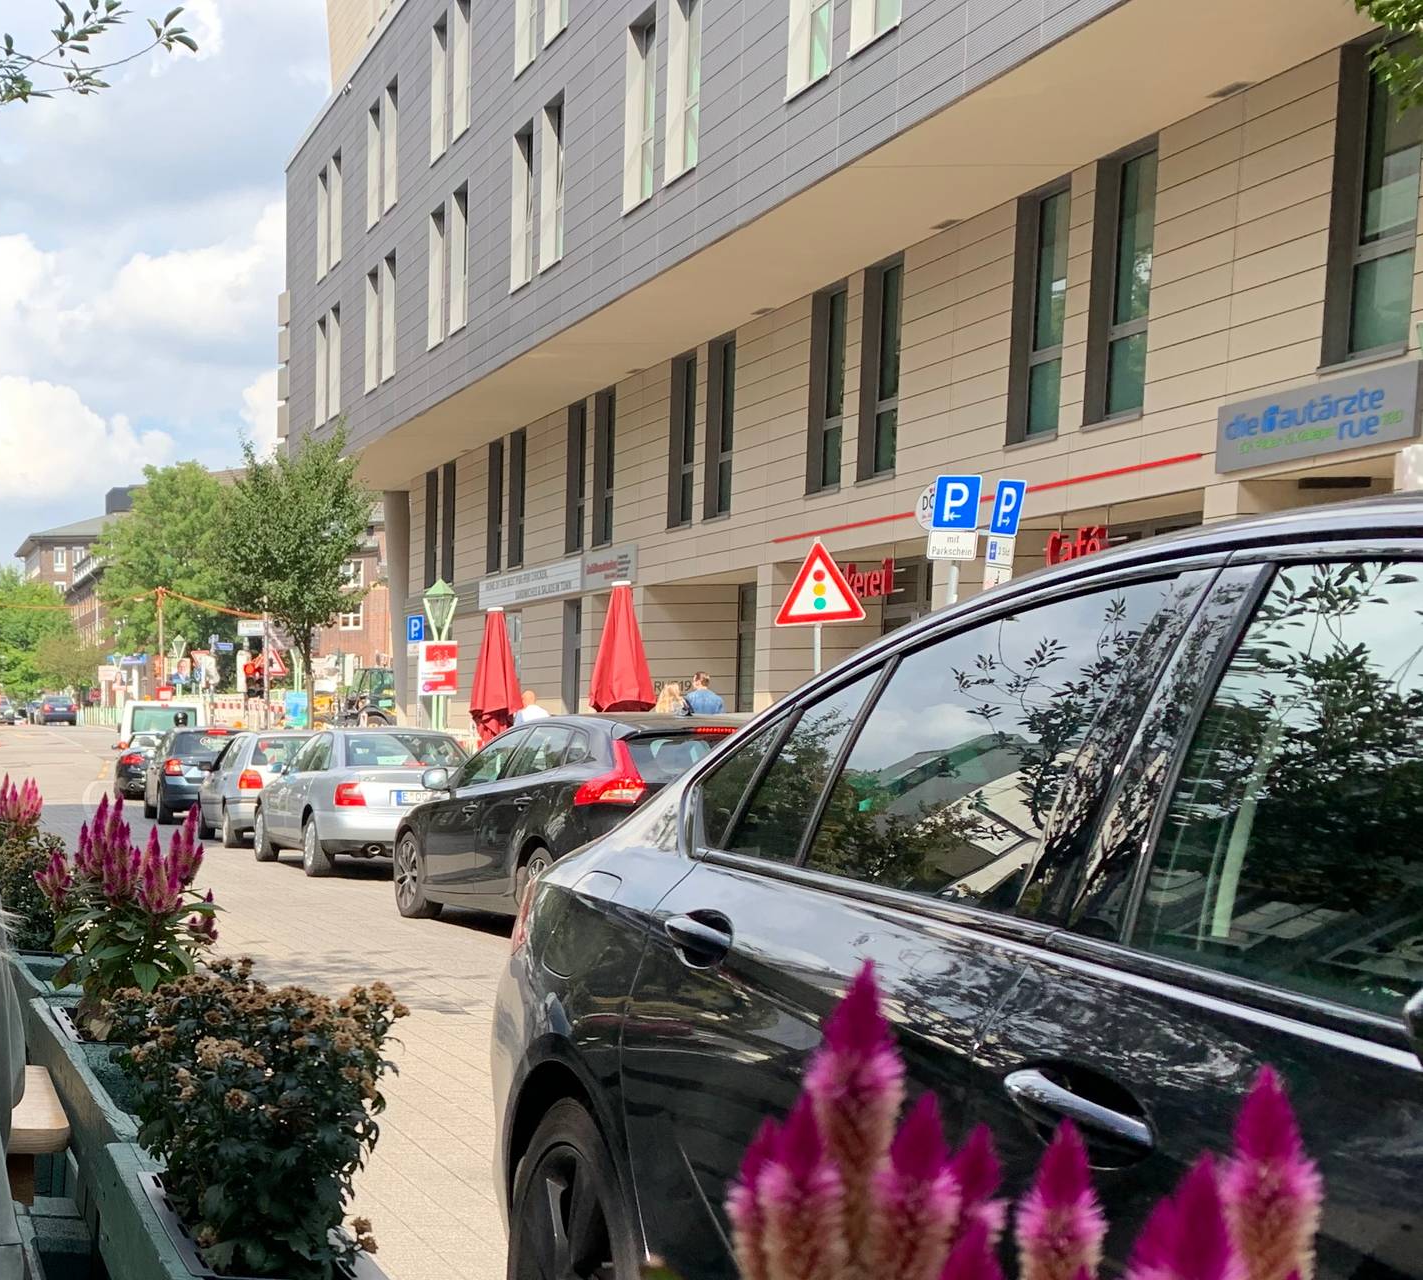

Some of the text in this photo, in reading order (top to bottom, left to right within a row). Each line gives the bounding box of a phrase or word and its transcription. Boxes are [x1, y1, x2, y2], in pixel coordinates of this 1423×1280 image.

[1224, 412, 1259, 441] die
[1337, 414, 1381, 441] rue
[942, 482, 970, 522] P
[996, 486, 1018, 528] P
[931, 546, 973, 557] Parkschein
[1046, 525, 1104, 568] Café
